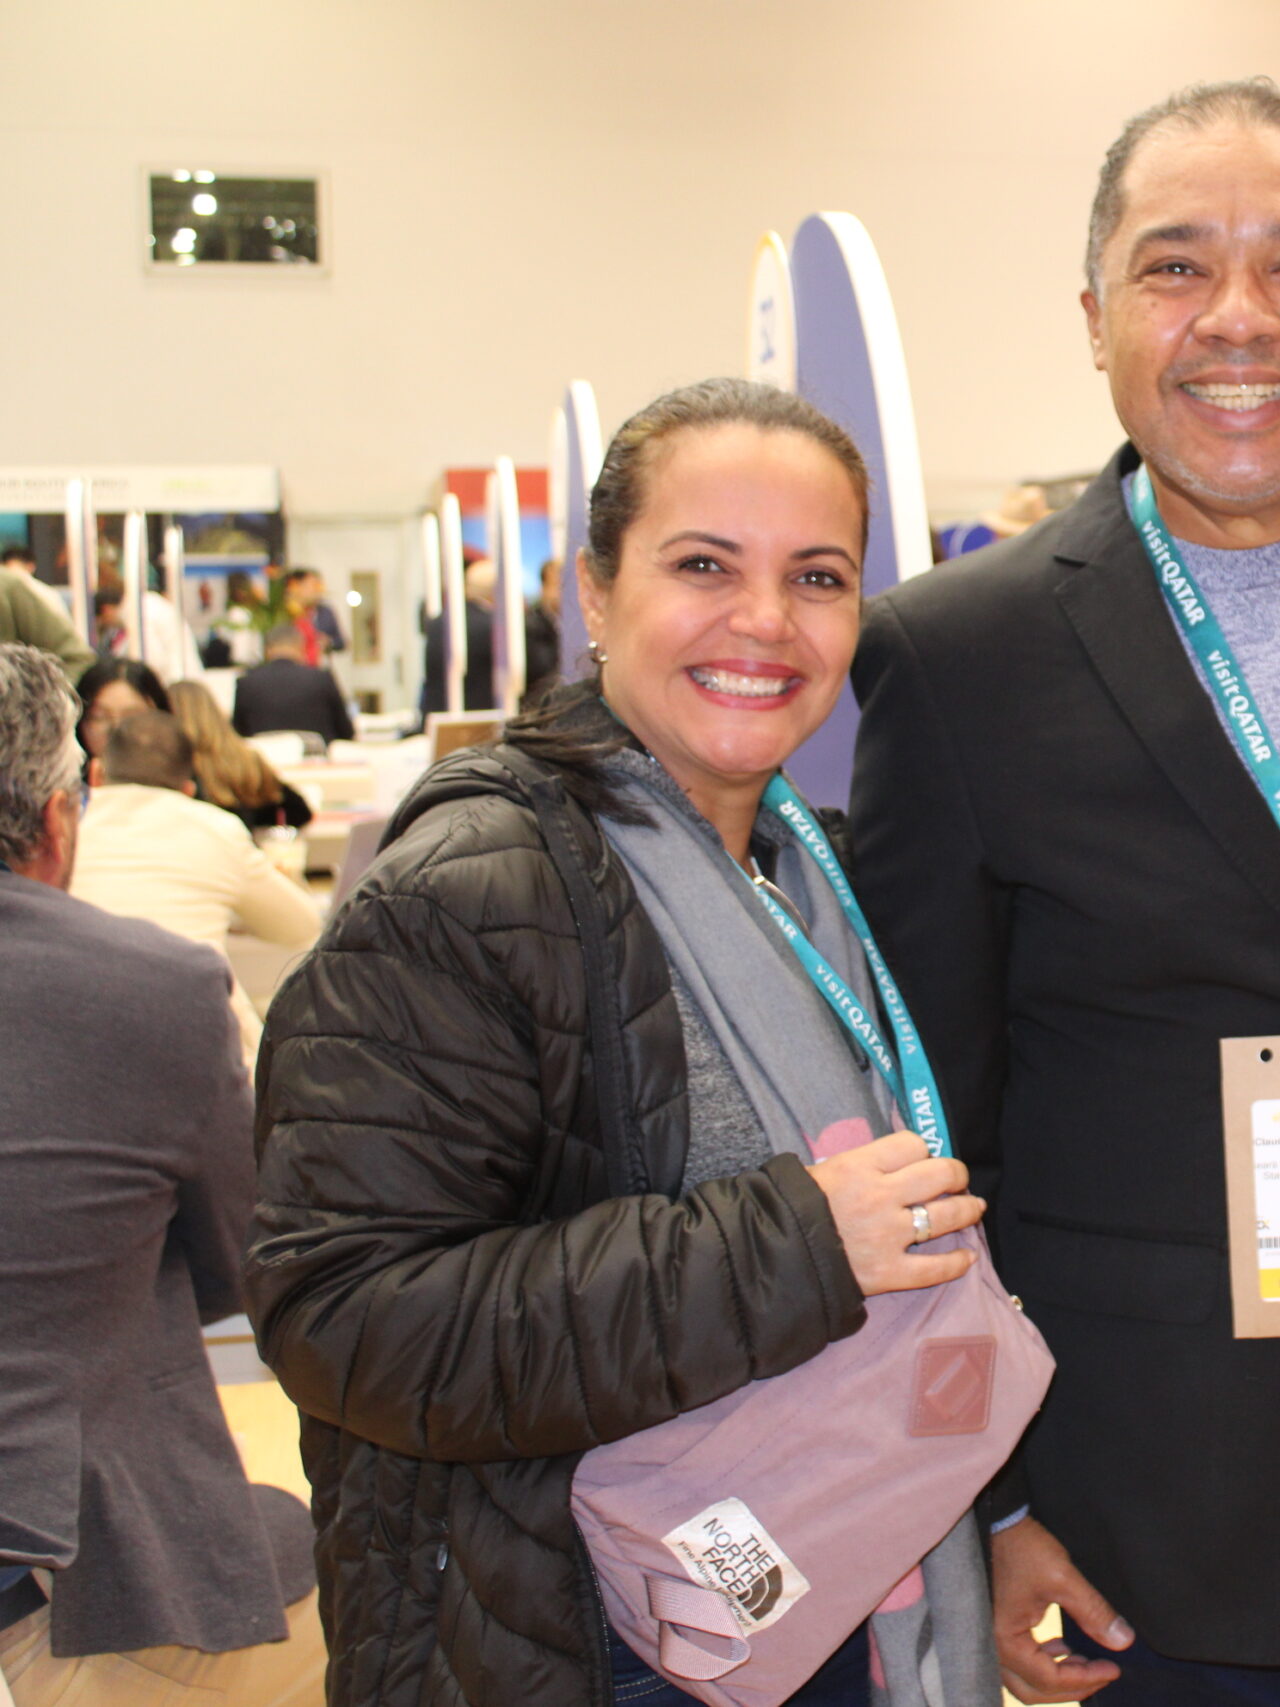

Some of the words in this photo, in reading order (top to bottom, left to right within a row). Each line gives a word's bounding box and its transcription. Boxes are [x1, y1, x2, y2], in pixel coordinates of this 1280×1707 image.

[1141, 520, 1205, 626] visitQATAR
[1207, 650, 1271, 764] visitQATAR
[779, 800, 852, 907] visitQATAR
[815, 964, 892, 1072] visitQATAR
[702, 1517, 761, 1584] NORTH
[702, 1547, 745, 1593] FACE
[741, 1533, 775, 1572] THE
